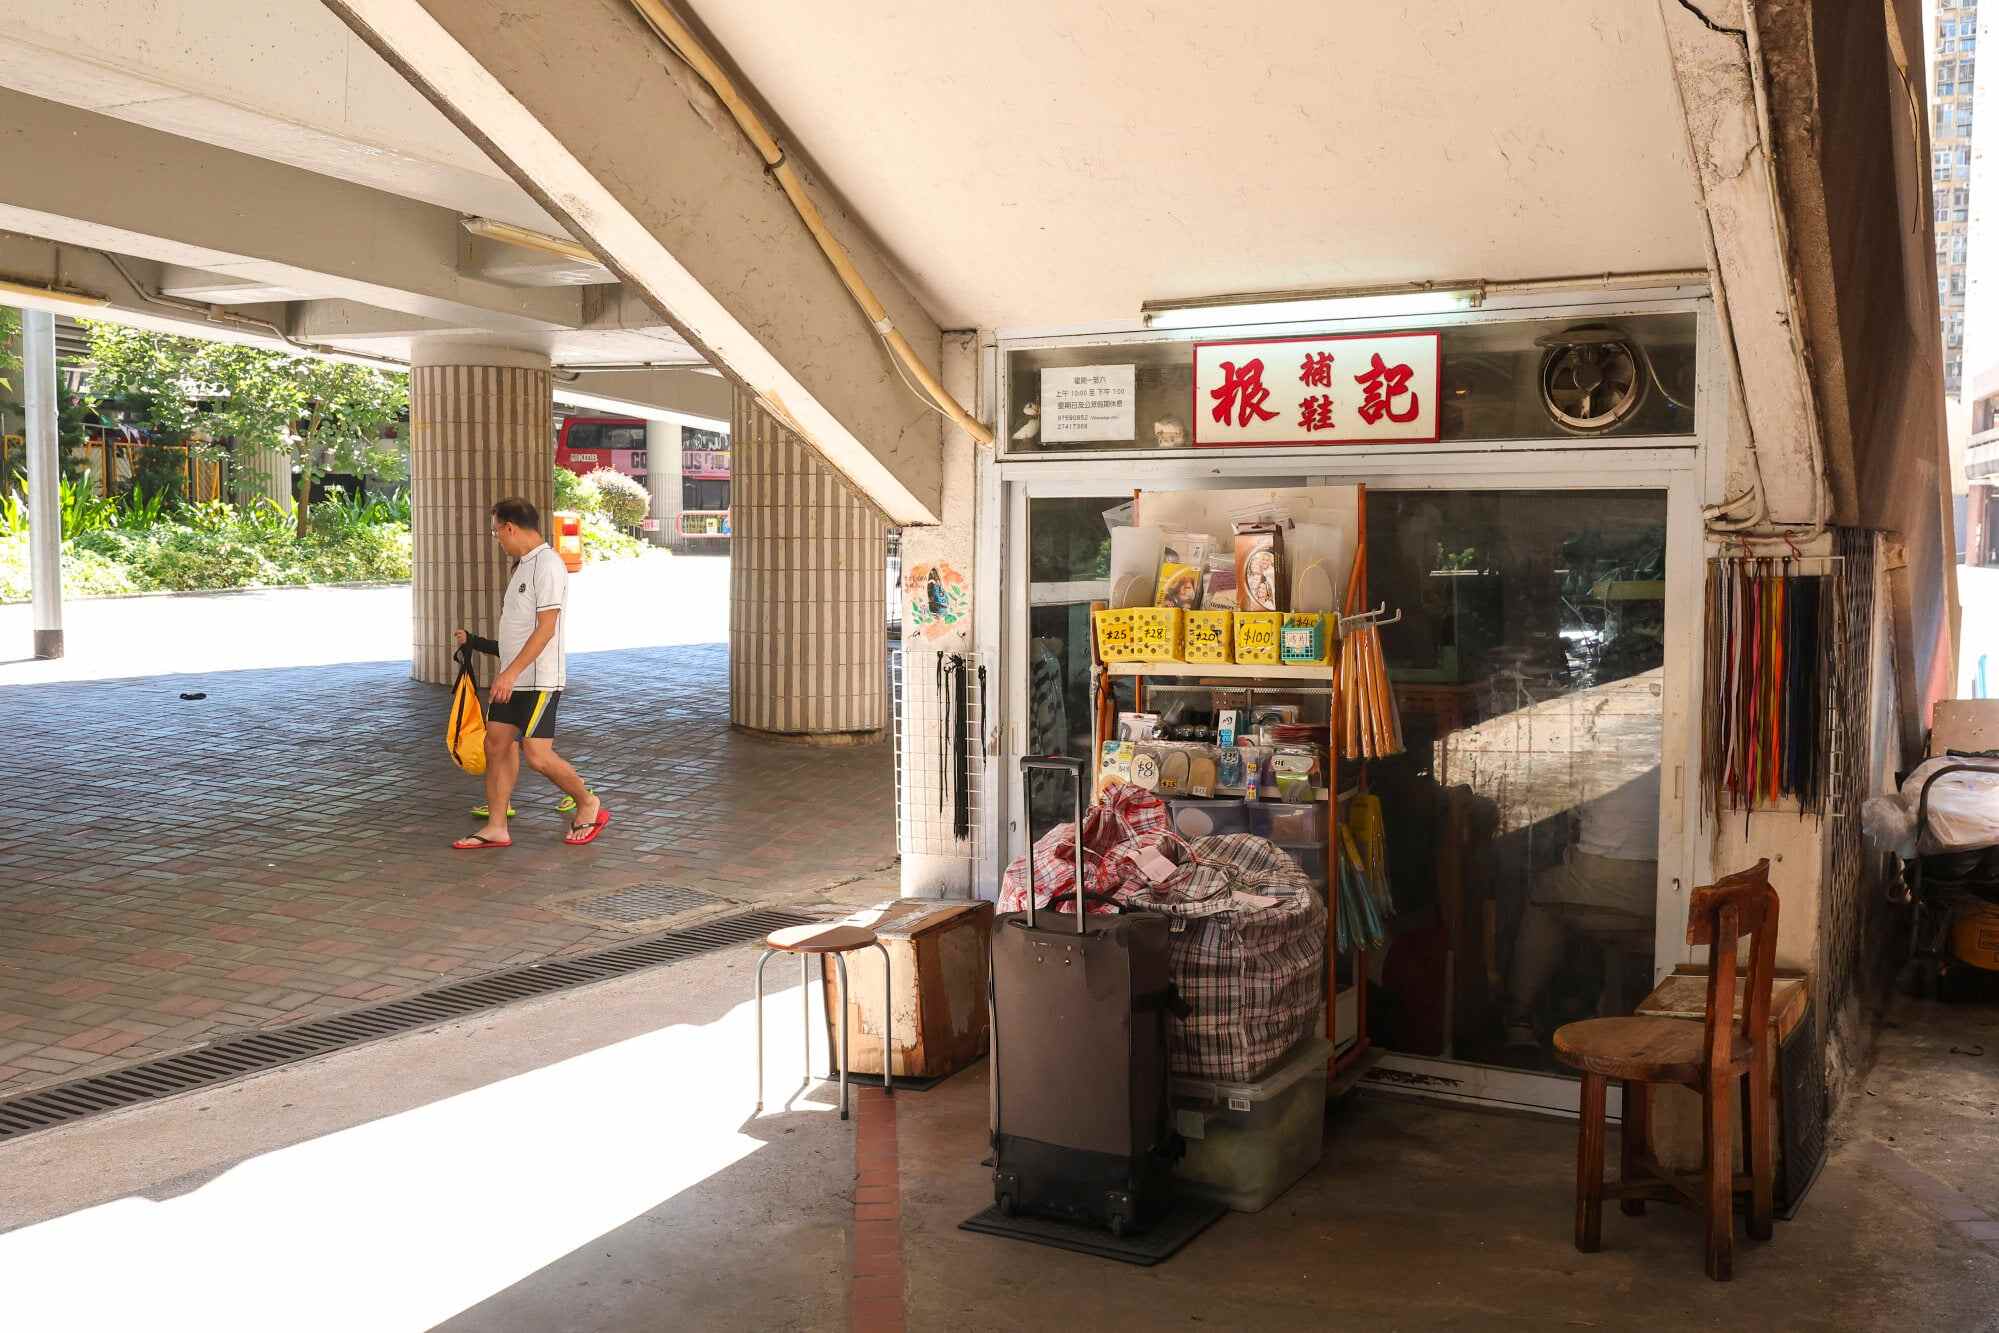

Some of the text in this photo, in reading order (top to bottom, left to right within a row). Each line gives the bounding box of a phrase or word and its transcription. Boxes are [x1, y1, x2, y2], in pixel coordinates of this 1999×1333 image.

[1210, 358, 1280, 427] 根
[1298, 351, 1335, 432] 補鞋
[1354, 353, 1419, 425] 記
[1244, 629, 1271, 644] $100
[1137, 761, 1153, 777] $8
